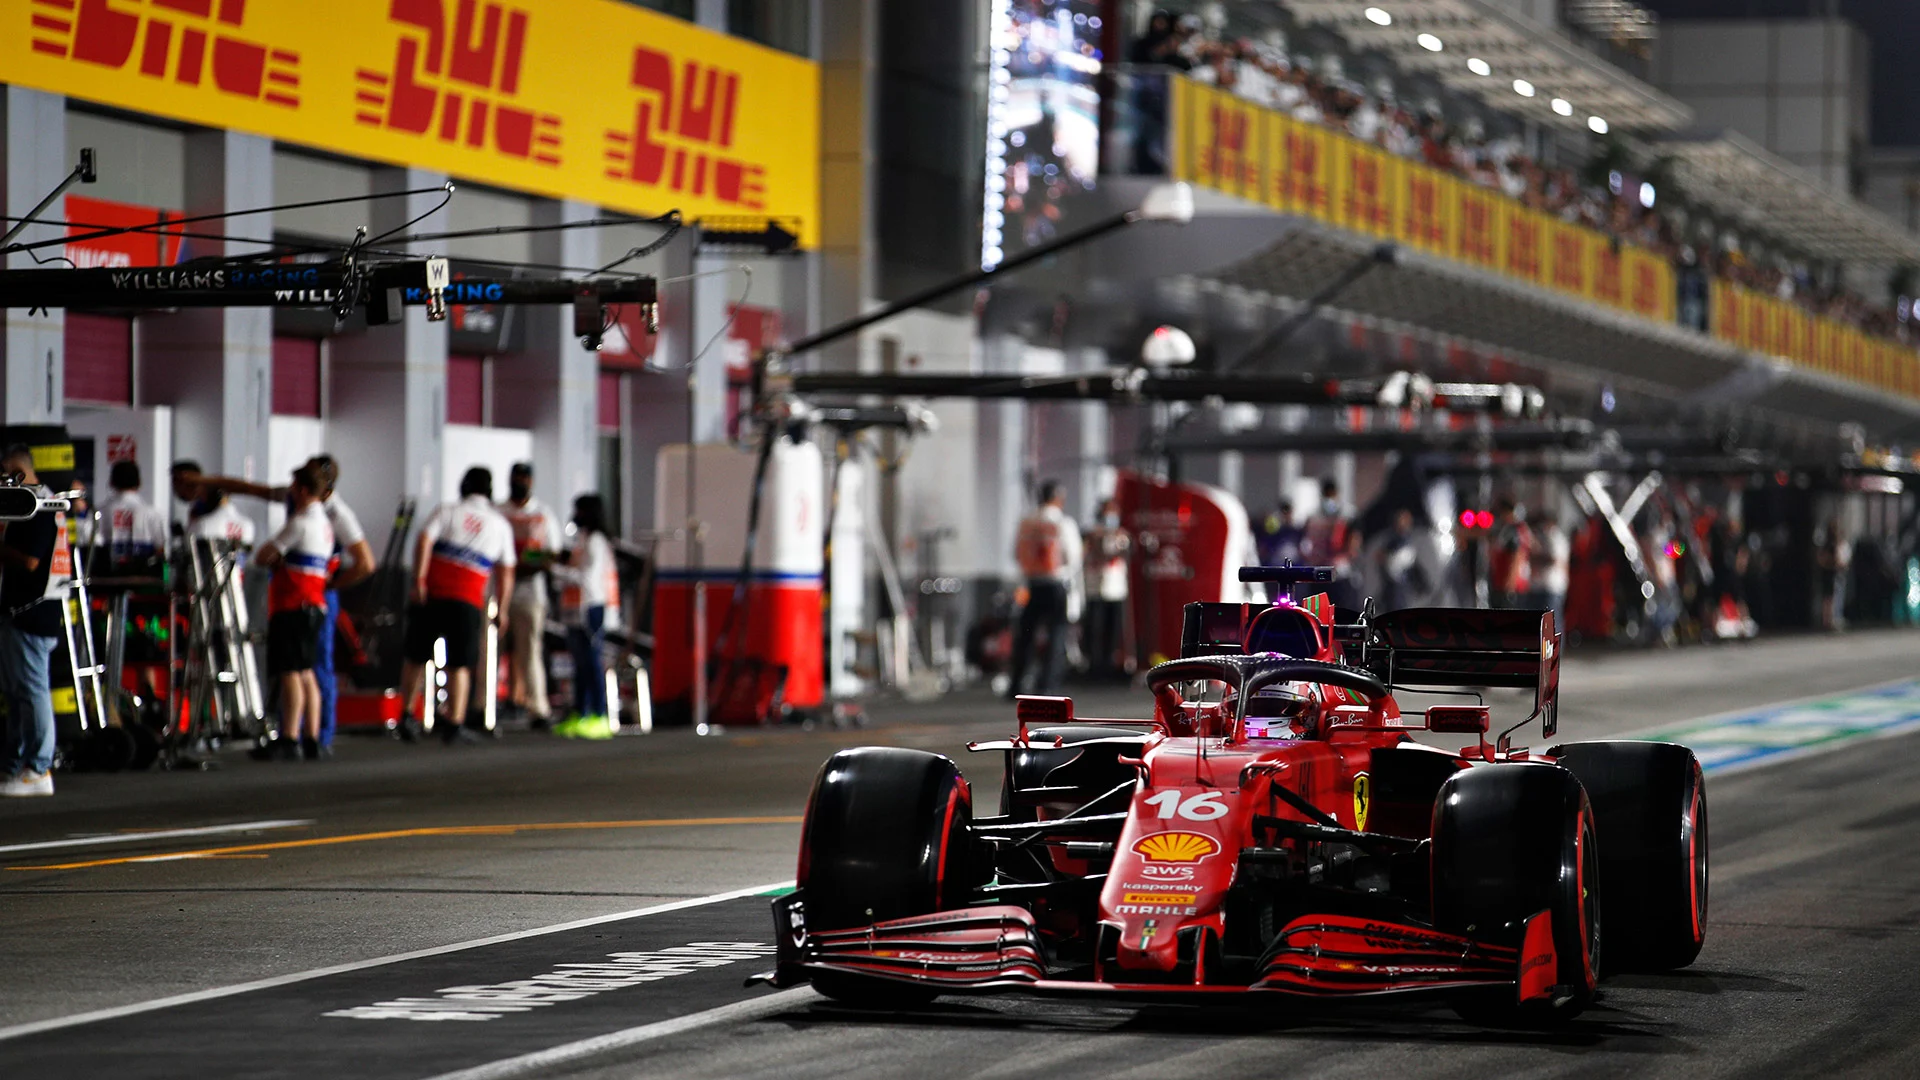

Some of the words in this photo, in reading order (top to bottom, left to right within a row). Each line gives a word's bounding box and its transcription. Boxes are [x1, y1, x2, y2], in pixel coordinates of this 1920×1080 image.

[630, 44, 742, 208] DHL
[111, 268, 227, 290] WILLIAMS
[431, 263, 445, 280] W
[405, 282, 504, 302] RCING
[1144, 790, 1229, 821] 16
[1142, 866, 1195, 877] aws
[1122, 882, 1204, 893] kaspersky
[1115, 905, 1197, 916] MAHLE
[898, 951, 984, 962] V-Power
[1361, 964, 1458, 974] V-Power
[321, 941, 778, 1021] #WeRaceAsOne
